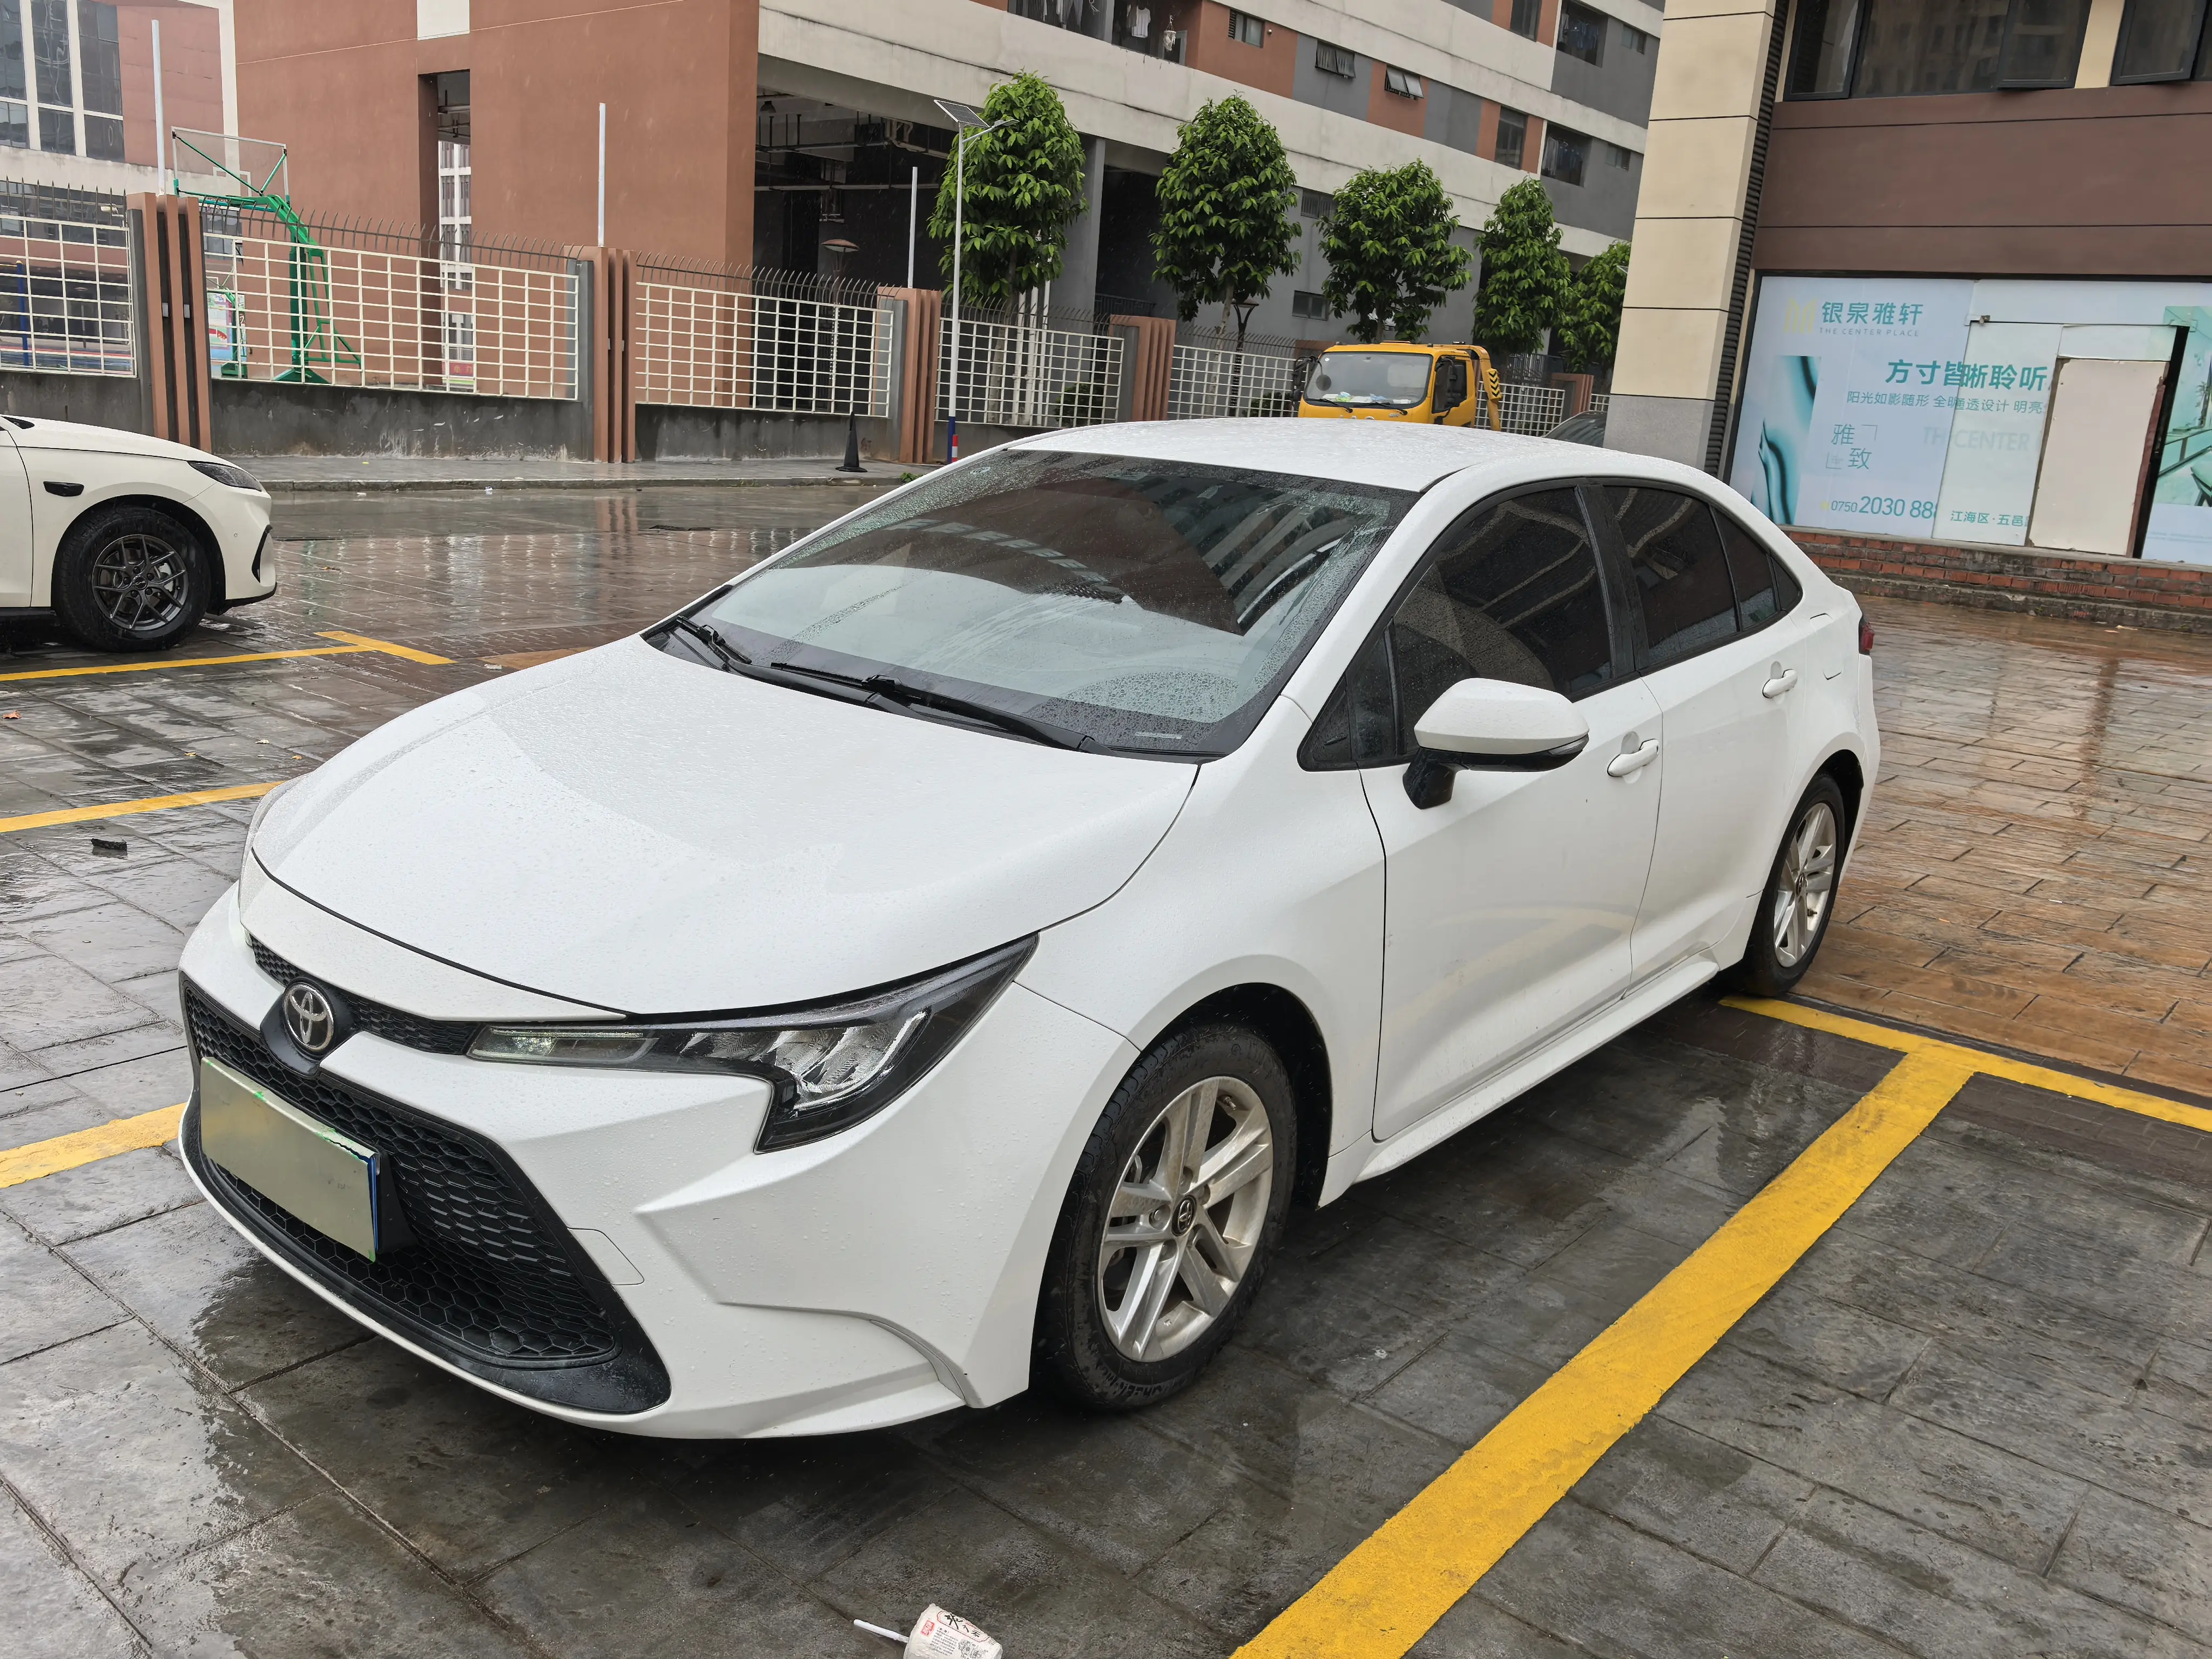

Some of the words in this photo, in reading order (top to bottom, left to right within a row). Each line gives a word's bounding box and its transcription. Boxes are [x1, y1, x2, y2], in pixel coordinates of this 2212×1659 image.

[1822, 301, 1924, 326] 银泉雅轩
[1842, 328, 1882, 336] CENTER
[1885, 359, 2051, 391] 方寸皆晰聆听
[1847, 390, 1930, 407] 阳光如影随形
[2013, 400, 2046, 414] 明亮
[1831, 423, 1855, 445] 雅
[1923, 426, 1947, 446] TH
[1954, 429, 2031, 451] CENTER
[1847, 448, 1872, 470] 致
[1831, 500, 1858, 512] 0750
[1859, 496, 1906, 517] 2030
[1909, 500, 1938, 519] 88
